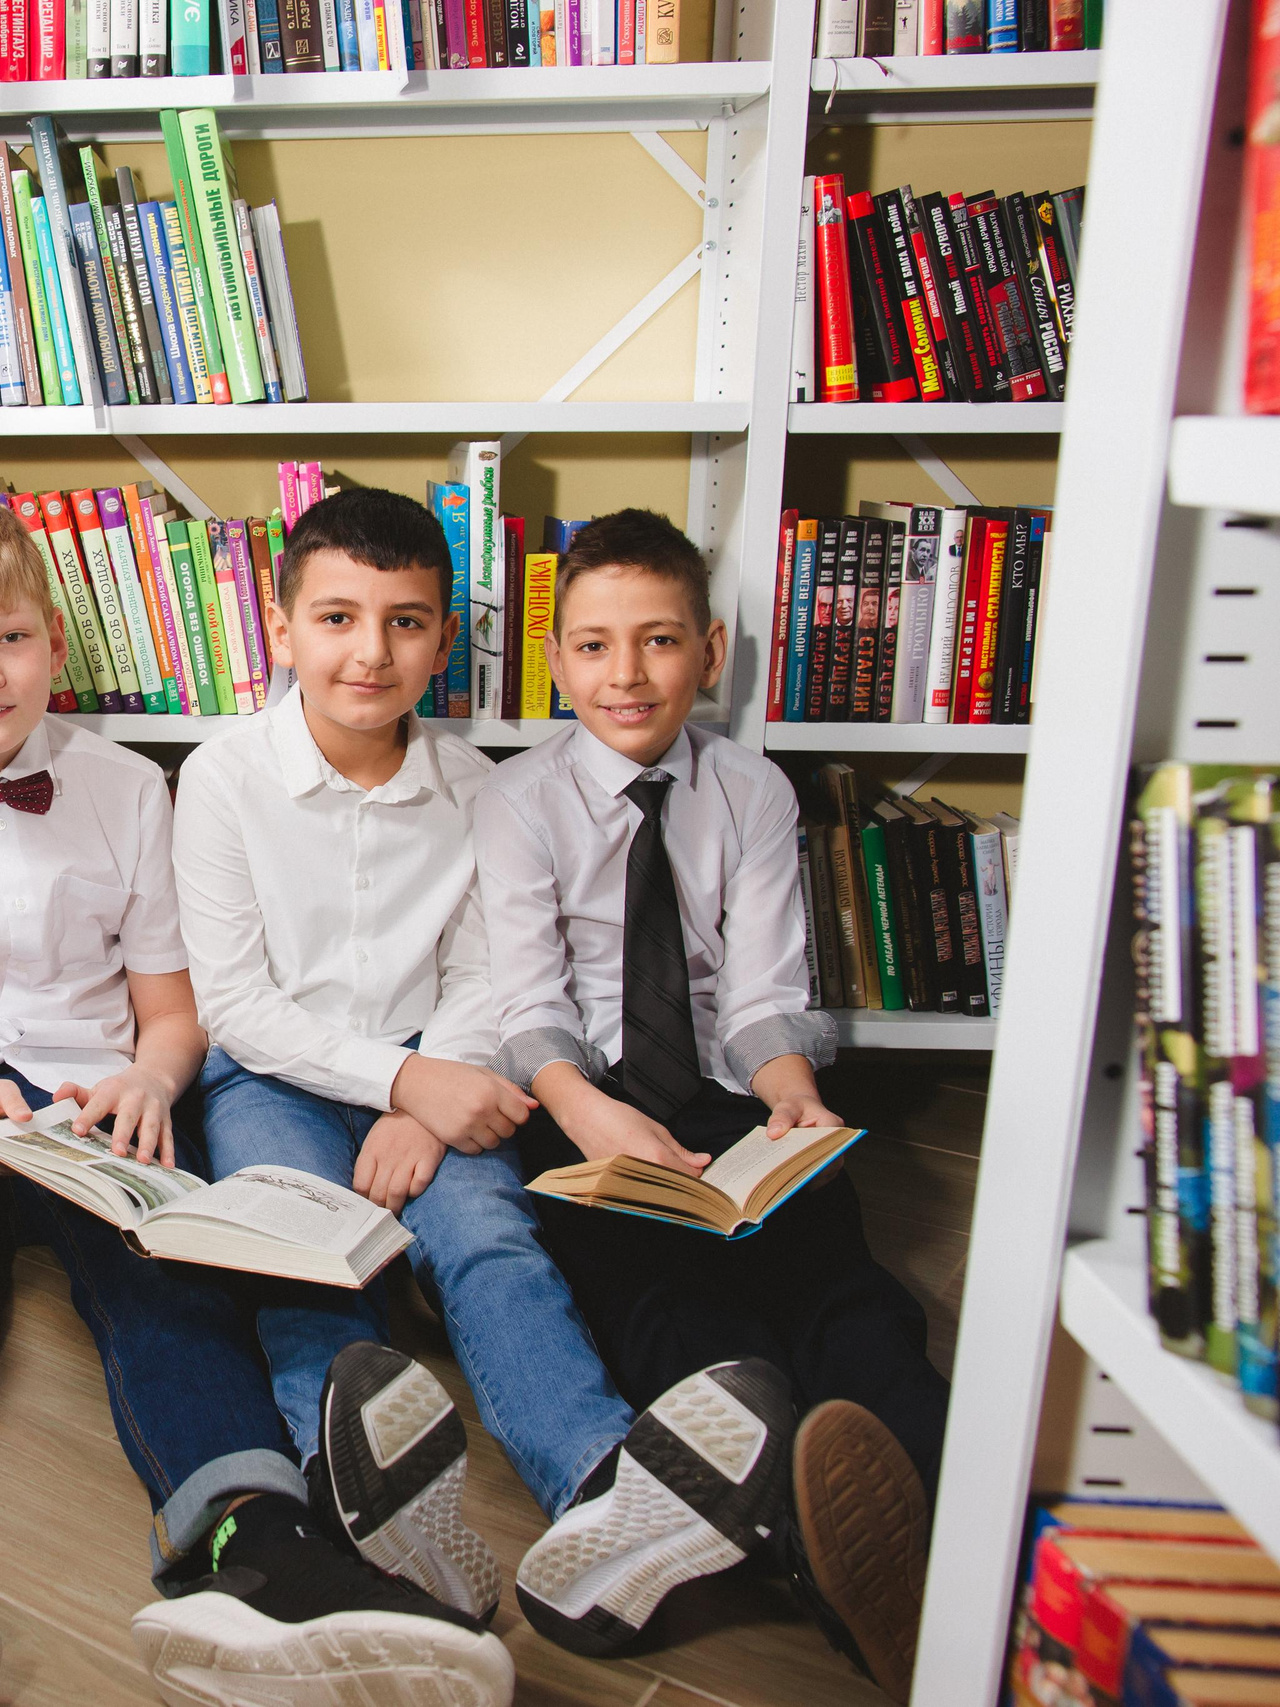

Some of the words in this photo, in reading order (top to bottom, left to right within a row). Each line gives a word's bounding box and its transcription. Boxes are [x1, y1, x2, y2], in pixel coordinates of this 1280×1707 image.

[42, 33, 54, 59] МИР
[194, 123, 221, 182] ДОРОГИ
[5, 216, 17, 259] КЛАДОВЫХ
[891, 202, 903, 232] ВОЙНЕ
[976, 216, 990, 240] АРМИЯ
[989, 211, 1004, 253] ВЕРМАХТА
[163, 206, 181, 244] ЮРИЙ
[173, 249, 195, 306] ГАГАРИН
[206, 186, 243, 322] АВТОМОБИЛЬНЫЕ
[243, 250, 256, 276] ПРАВА
[902, 250, 913, 278] БЛАГА
[982, 242, 996, 274] КРАСНАЯ
[997, 254, 1010, 278] ПРОТИВ
[84, 260, 102, 301] РЕМОНТ
[908, 282, 917, 297] НЕТ
[919, 256, 929, 278] БИТВА
[925, 291, 940, 318] МОСКВУ
[91, 303, 116, 374] АВТОМОБИЛЕЙ
[166, 324, 181, 359] Школа
[912, 299, 928, 355] Солонин
[1039, 321, 1064, 374] РОССИИ
[922, 356, 940, 395] Марк
[452, 511, 466, 524] Я
[114, 534, 133, 581] КУЛЬТУРЫ
[452, 541, 466, 552] А
[1015, 524, 1028, 555] МЫ?
[61, 549, 89, 616] ОВОЩАХ
[91, 549, 118, 616] ОВОЩАХ
[180, 562, 197, 610] ОГОРОД
[1012, 560, 1024, 589] КТО
[124, 583, 142, 626] ЯГОДНЫЕ
[206, 602, 219, 629] МОЙ
[527, 559, 553, 640] ОХОТНИКА
[80, 619, 97, 641] ОБ
[108, 619, 124, 641] ОБ
[188, 612, 201, 634] БЕЗ
[912, 587, 930, 660] ГРОМЫКО
[960, 599, 977, 679] ИМПЕРИЯ
[87, 645, 107, 675] ВСЕ
[114, 645, 133, 675] ВСЕ
[135, 636, 155, 686] ПЛОДОВЫЕ
[192, 636, 210, 687] ОШИБОК
[209, 630, 227, 676] ОГОРОД
[810, 630, 826, 716] АНДРОПОВ
[829, 629, 849, 705] ХРУЩЕВ
[525, 642, 537, 712] ДРАГОЦЕННАЯ
[853, 636, 875, 713] СТАЛИН
[835, 849, 850, 908] КУПЕЧЕСКАЯ
[874, 863, 887, 899] ЛЕГЕНДЫ
[841, 909, 856, 947] МОСКВА
[879, 901, 891, 931] ЧЕРНОЙ
[883, 932, 895, 965] СЛЕДАМ
[886, 966, 896, 977] ПО
